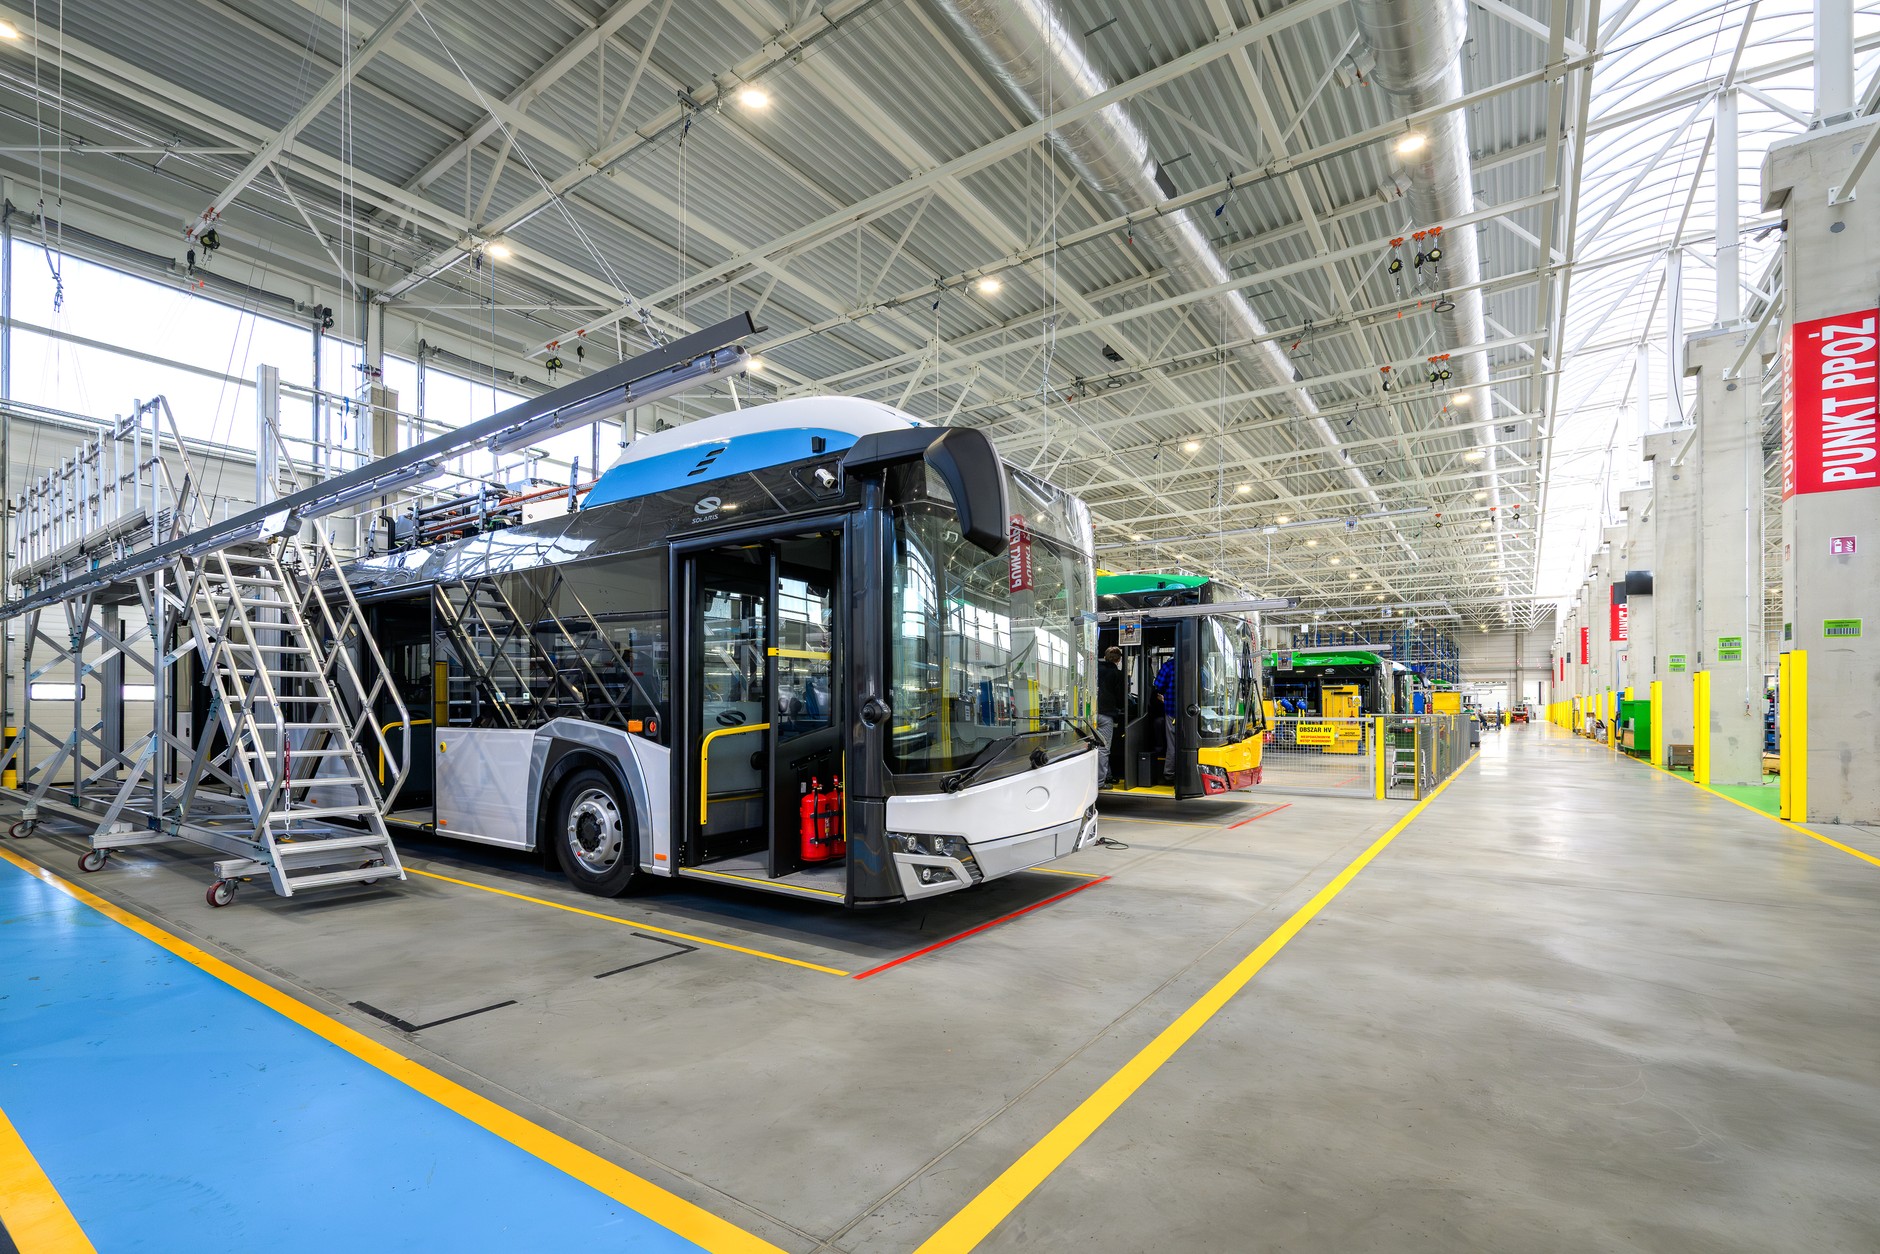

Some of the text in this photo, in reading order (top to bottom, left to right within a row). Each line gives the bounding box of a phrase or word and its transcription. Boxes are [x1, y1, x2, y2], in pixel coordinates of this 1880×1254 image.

[1808, 316, 1876, 483] PUNKT PPOŻ
[1784, 411, 1793, 493] PUNKT
[692, 514, 718, 524] SOLARIS
